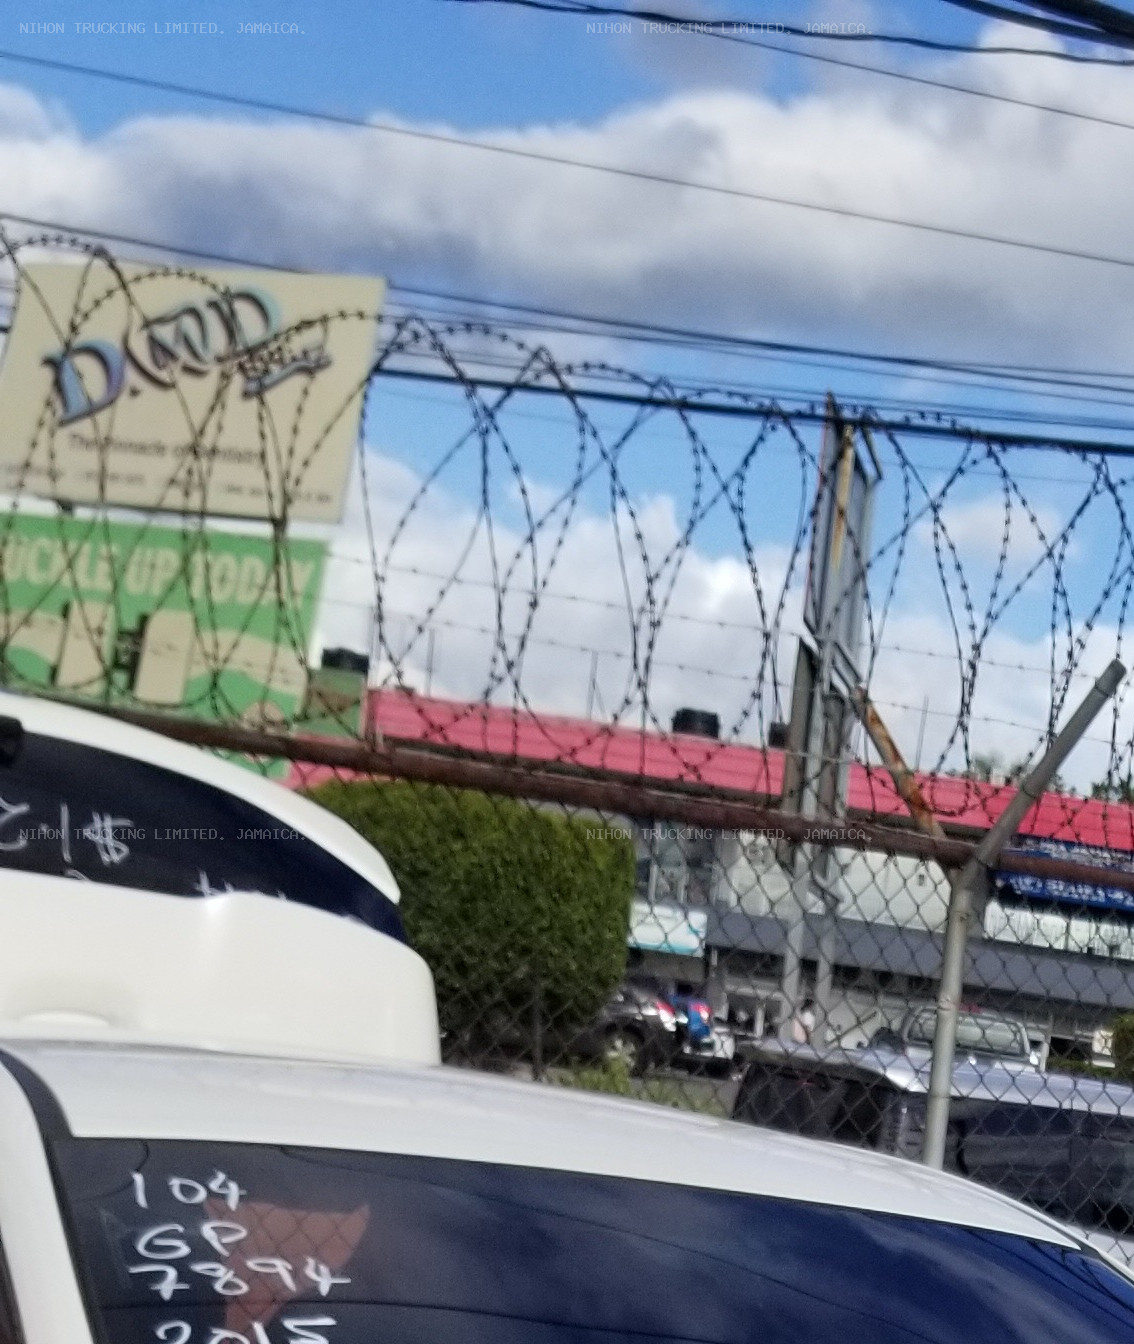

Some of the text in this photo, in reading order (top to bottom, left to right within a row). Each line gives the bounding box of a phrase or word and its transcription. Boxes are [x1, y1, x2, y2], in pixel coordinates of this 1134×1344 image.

[132, 1171, 247, 1211] 104
[136, 1220, 248, 1259] GP
[128, 1256, 351, 1300] 7894
